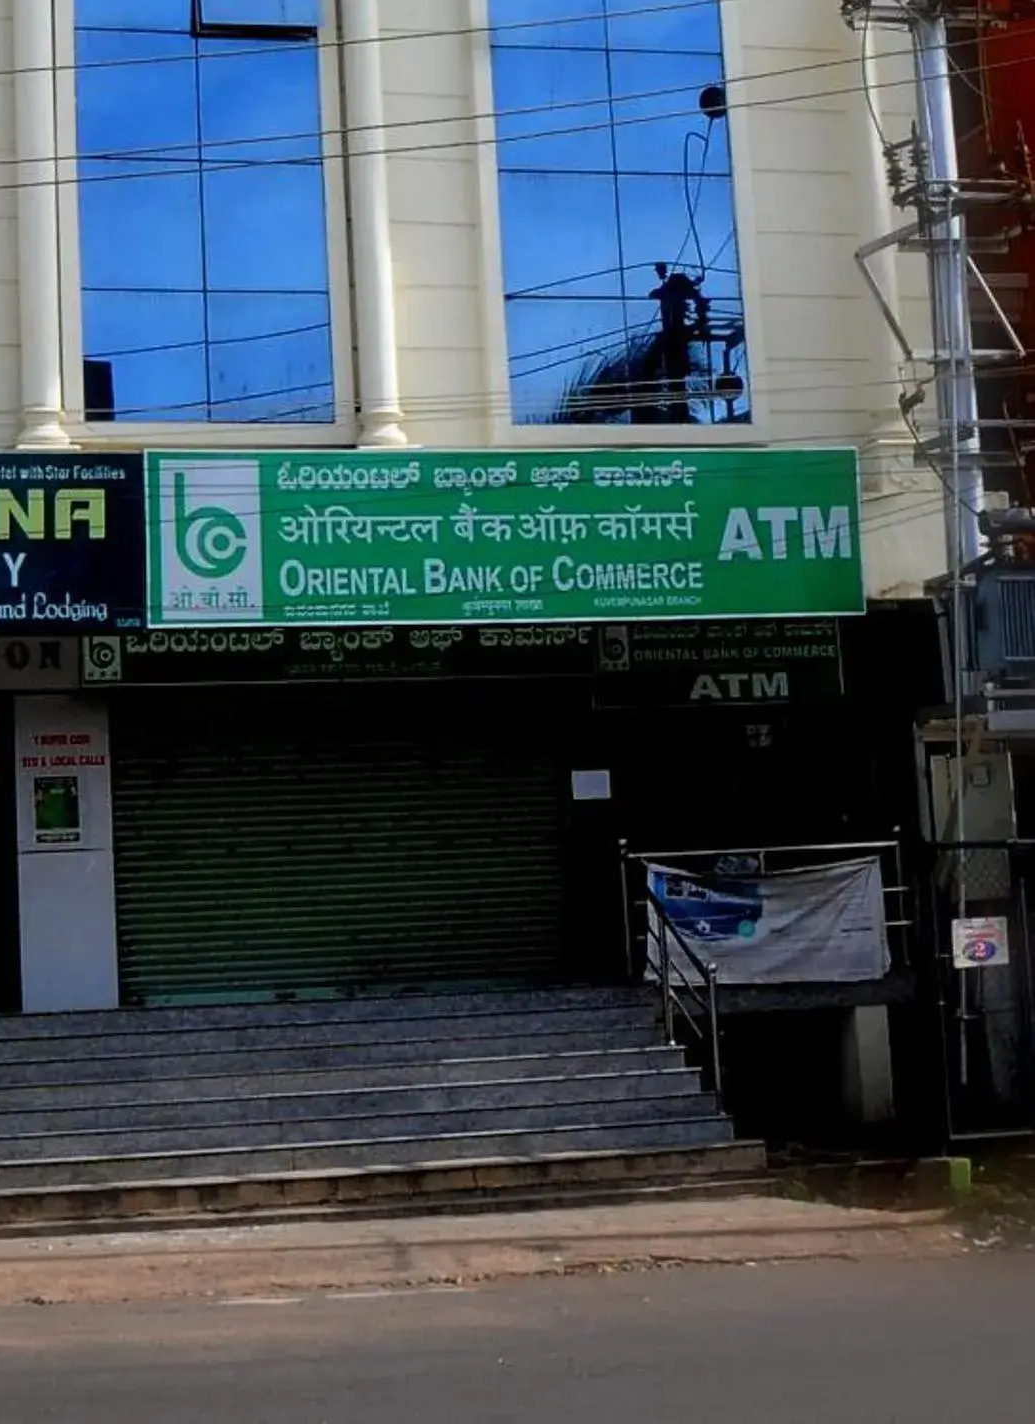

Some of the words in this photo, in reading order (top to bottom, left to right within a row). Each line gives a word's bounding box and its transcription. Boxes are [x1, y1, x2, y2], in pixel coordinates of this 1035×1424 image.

[45, 465, 70, 480] Star
[717, 505, 852, 561] ATM
[279, 559, 416, 596] ORIENTAL
[424, 558, 502, 594] BANK
[510, 564, 544, 592] OF
[552, 555, 703, 591] COMMERCE
[33, 592, 107, 622] Lodging
[689, 671, 789, 700] ATM
